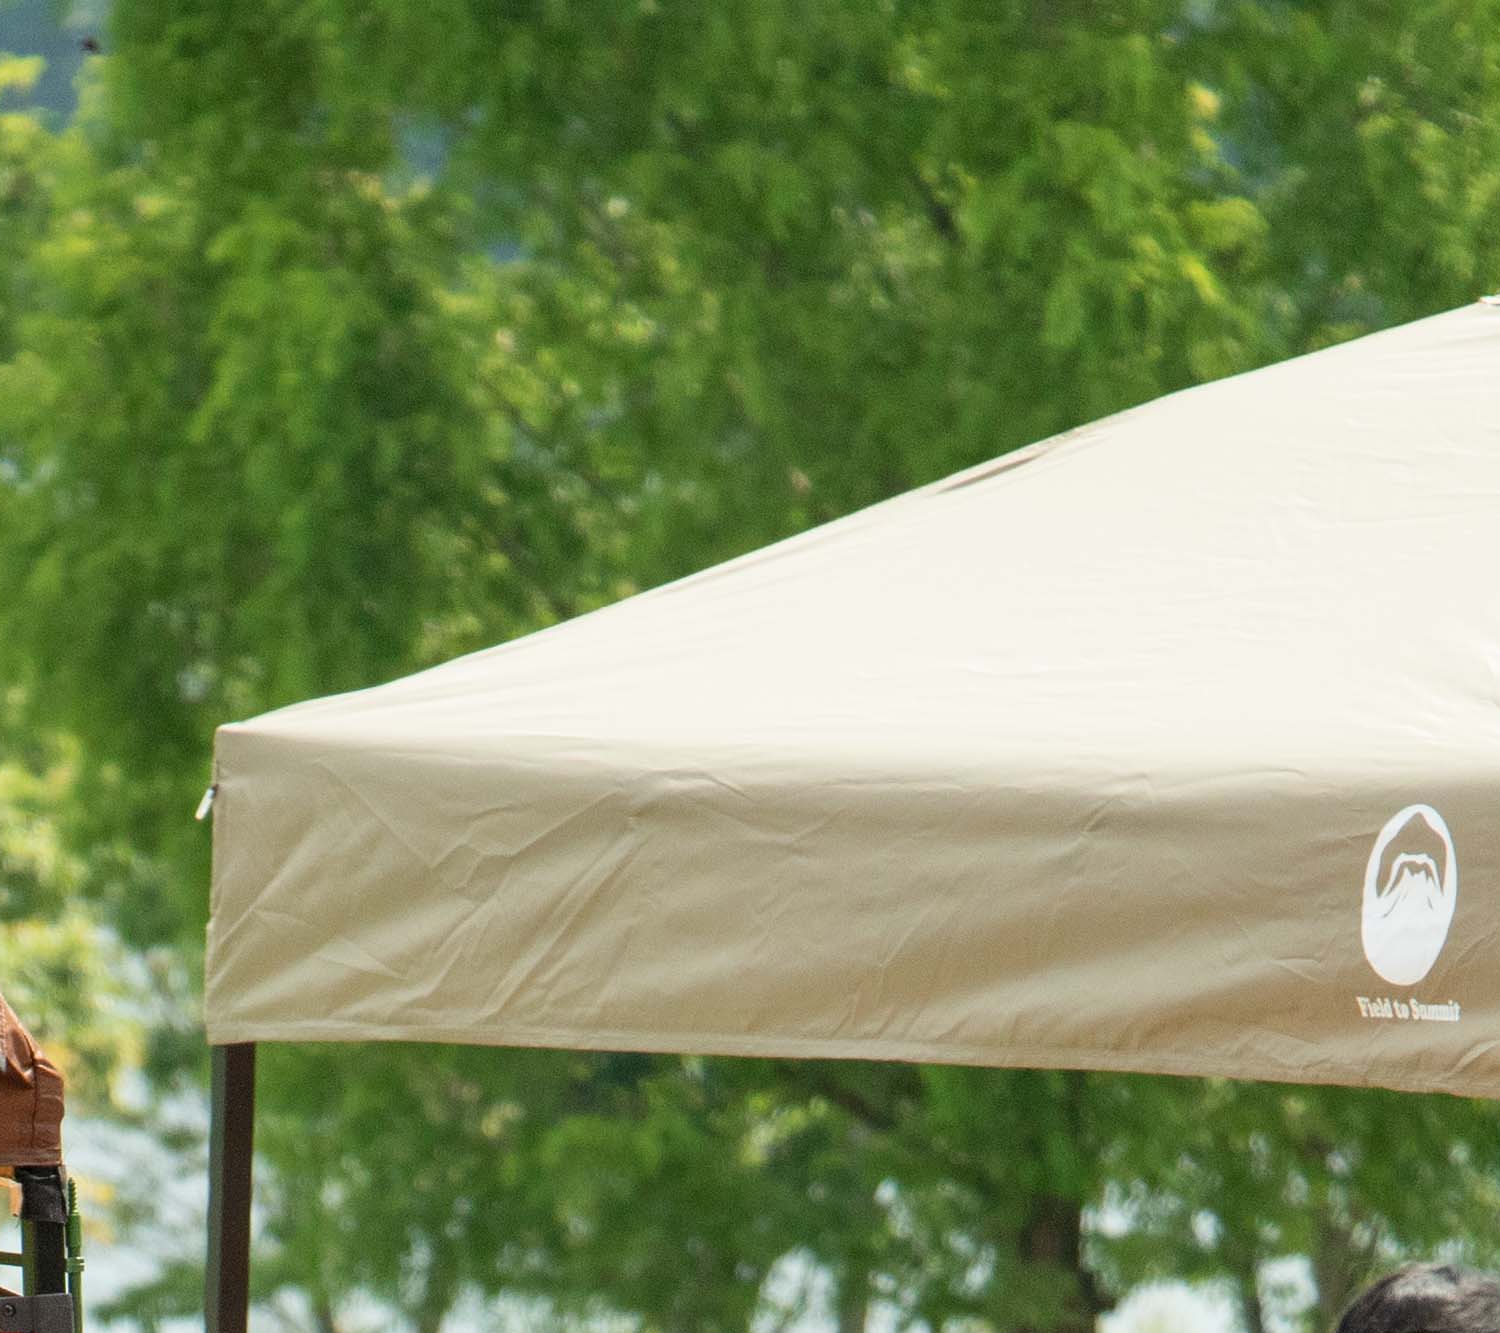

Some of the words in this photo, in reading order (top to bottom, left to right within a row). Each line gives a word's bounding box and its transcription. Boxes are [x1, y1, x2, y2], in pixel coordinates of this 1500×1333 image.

[1356, 997, 1392, 1018] Field
[1394, 999, 1409, 1018] to
[1411, 999, 1461, 1021] Summit
